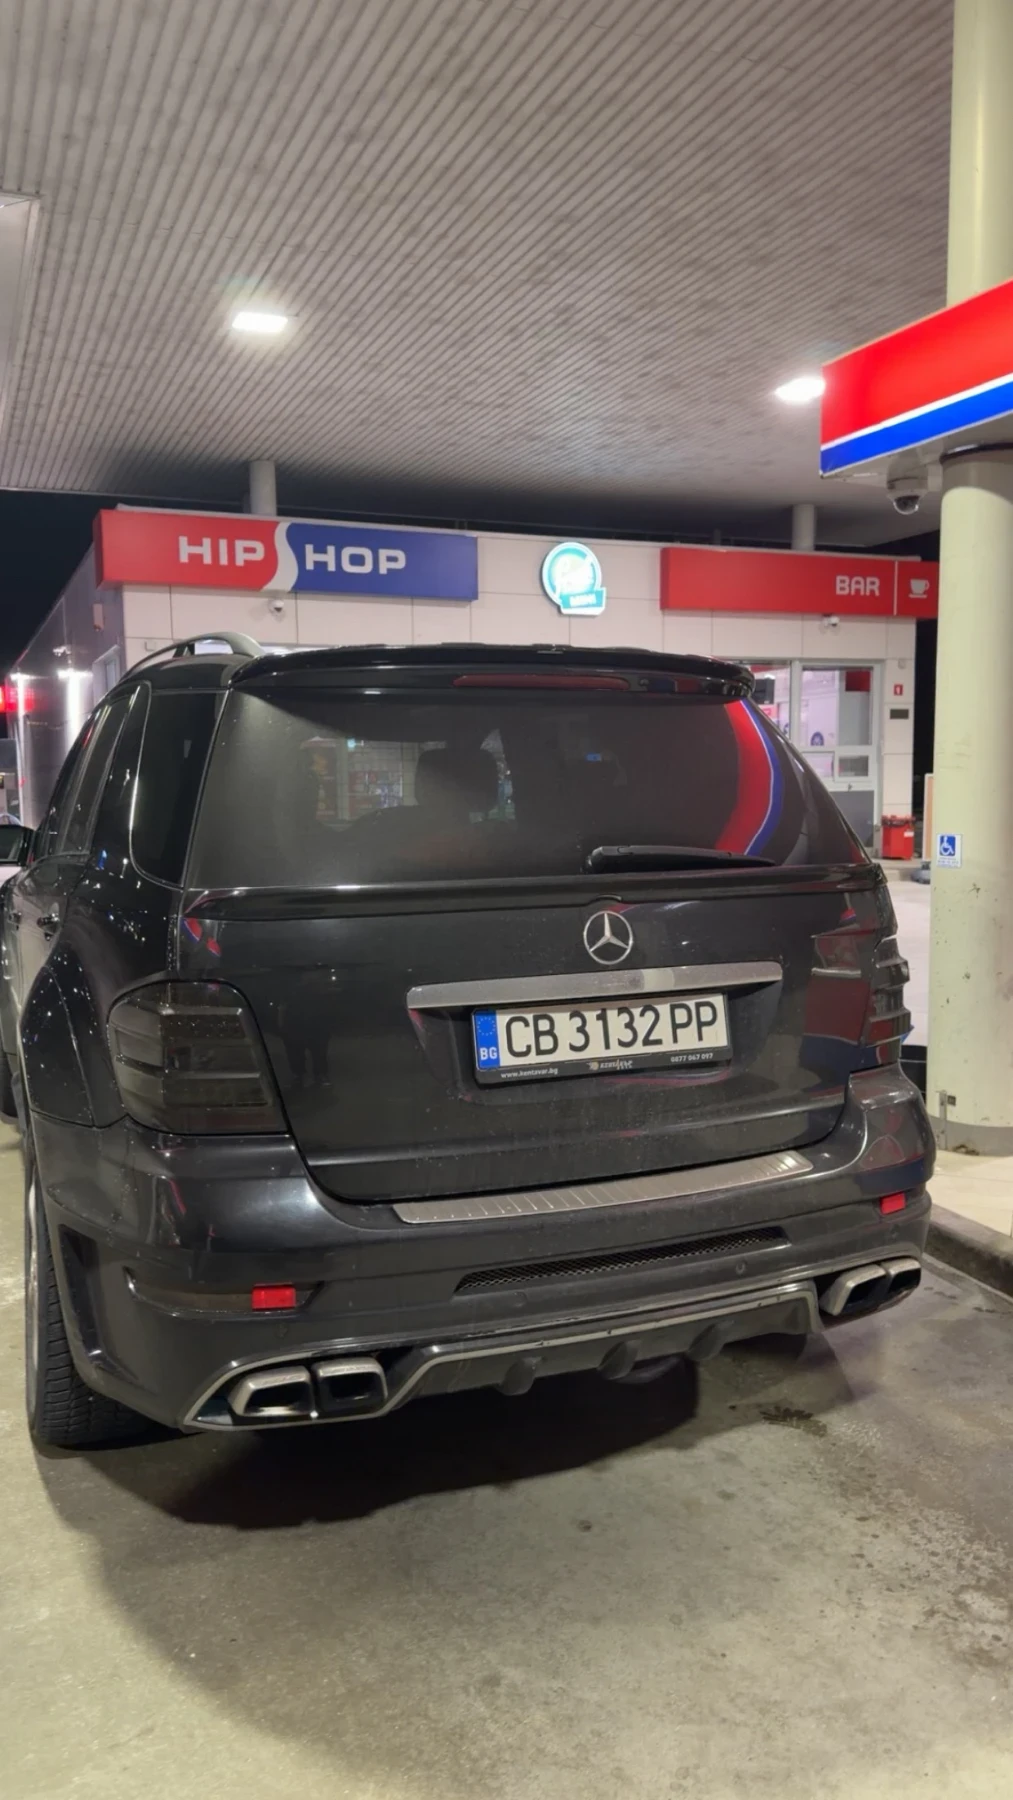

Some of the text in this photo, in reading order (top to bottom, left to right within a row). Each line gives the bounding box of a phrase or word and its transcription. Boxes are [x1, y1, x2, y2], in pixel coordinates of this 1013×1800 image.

[178, 535, 407, 575] HIP HOP
[835, 574, 880, 597] BAR
[505, 1001, 718, 1058] CB 3132 PP
[480, 1047, 498, 1061] BG
